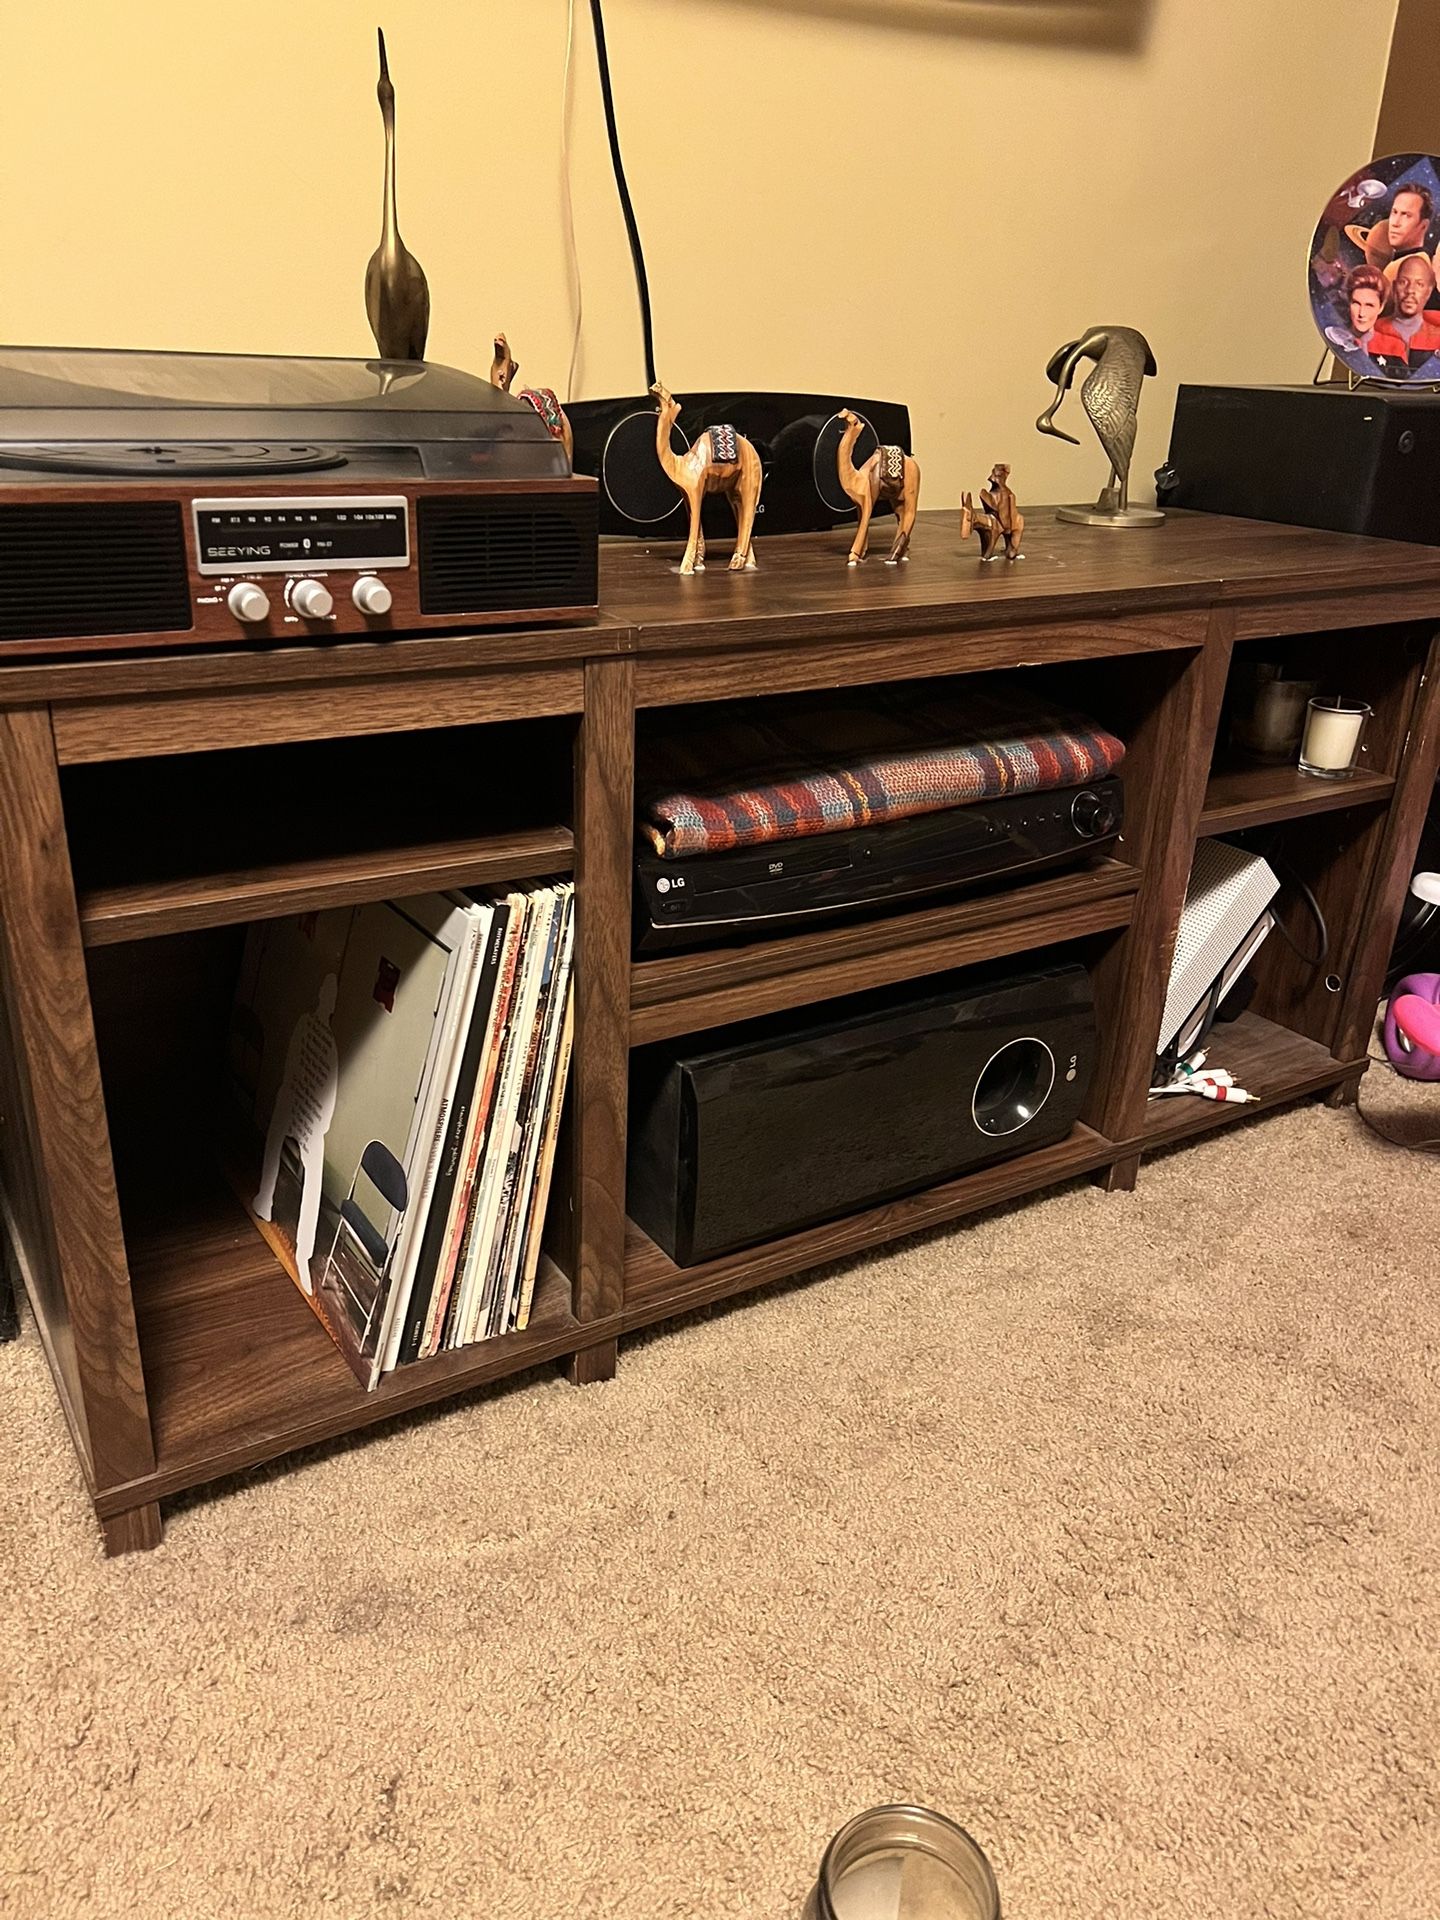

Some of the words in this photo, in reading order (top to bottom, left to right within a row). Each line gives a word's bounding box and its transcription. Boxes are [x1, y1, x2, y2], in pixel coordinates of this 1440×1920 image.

[207, 545, 271, 557] SEEYING
[768, 862, 783, 870] DVD
[671, 877, 686, 888] LG
[490, 927, 503, 965] RHYMESAYERS
[432, 1097, 448, 1143] ATMOSPHERE
